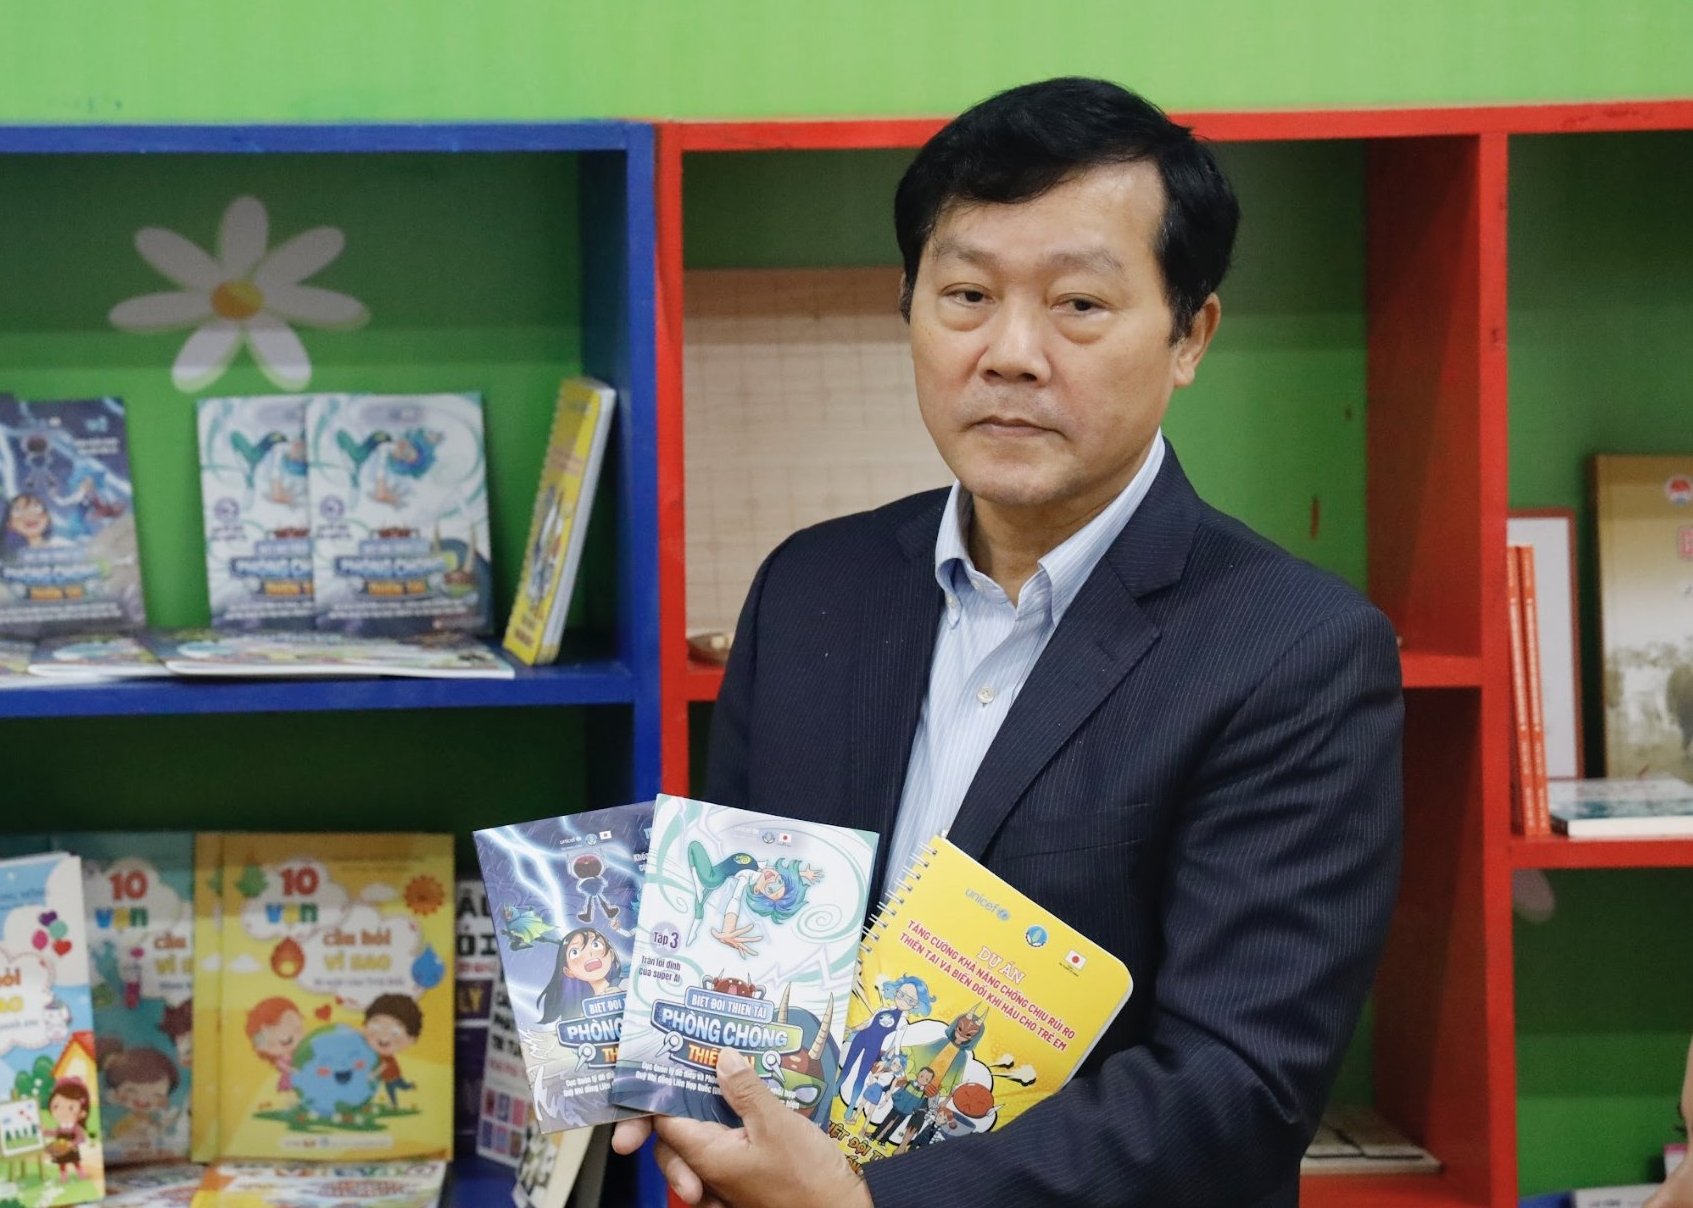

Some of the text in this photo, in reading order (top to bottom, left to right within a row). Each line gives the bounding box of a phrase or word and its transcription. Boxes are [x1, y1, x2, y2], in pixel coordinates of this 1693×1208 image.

[108, 870, 148, 901] 10
[281, 866, 319, 897] 10
[965, 887, 1000, 913] unicef
[154, 931, 187, 949] câu
[323, 927, 391, 947] câu hỏi
[670, 931, 679, 949] 3
[0, 966, 21, 987] ỏi
[653, 969, 673, 981] super
[907, 919, 931, 941] TĂNG
[958, 955, 976, 973] KHẢ
[1000, 983, 1028, 1008] CHỐNG
[1027, 1003, 1051, 1023] CHỊU
[1048, 1014, 1065, 1032] RỦI
[1063, 1026, 1076, 1040] RO
[924, 950, 940, 964] TAI
[1018, 1015, 1037, 1032] CHO
[1035, 1025, 1054, 1042] TRẺ
[1052, 1037, 1067, 1051] EM
[662, 1008, 721, 1044] PHÒNG
[688, 1044, 721, 1067] THIÊ
[828, 1120, 850, 1141] IỆT
